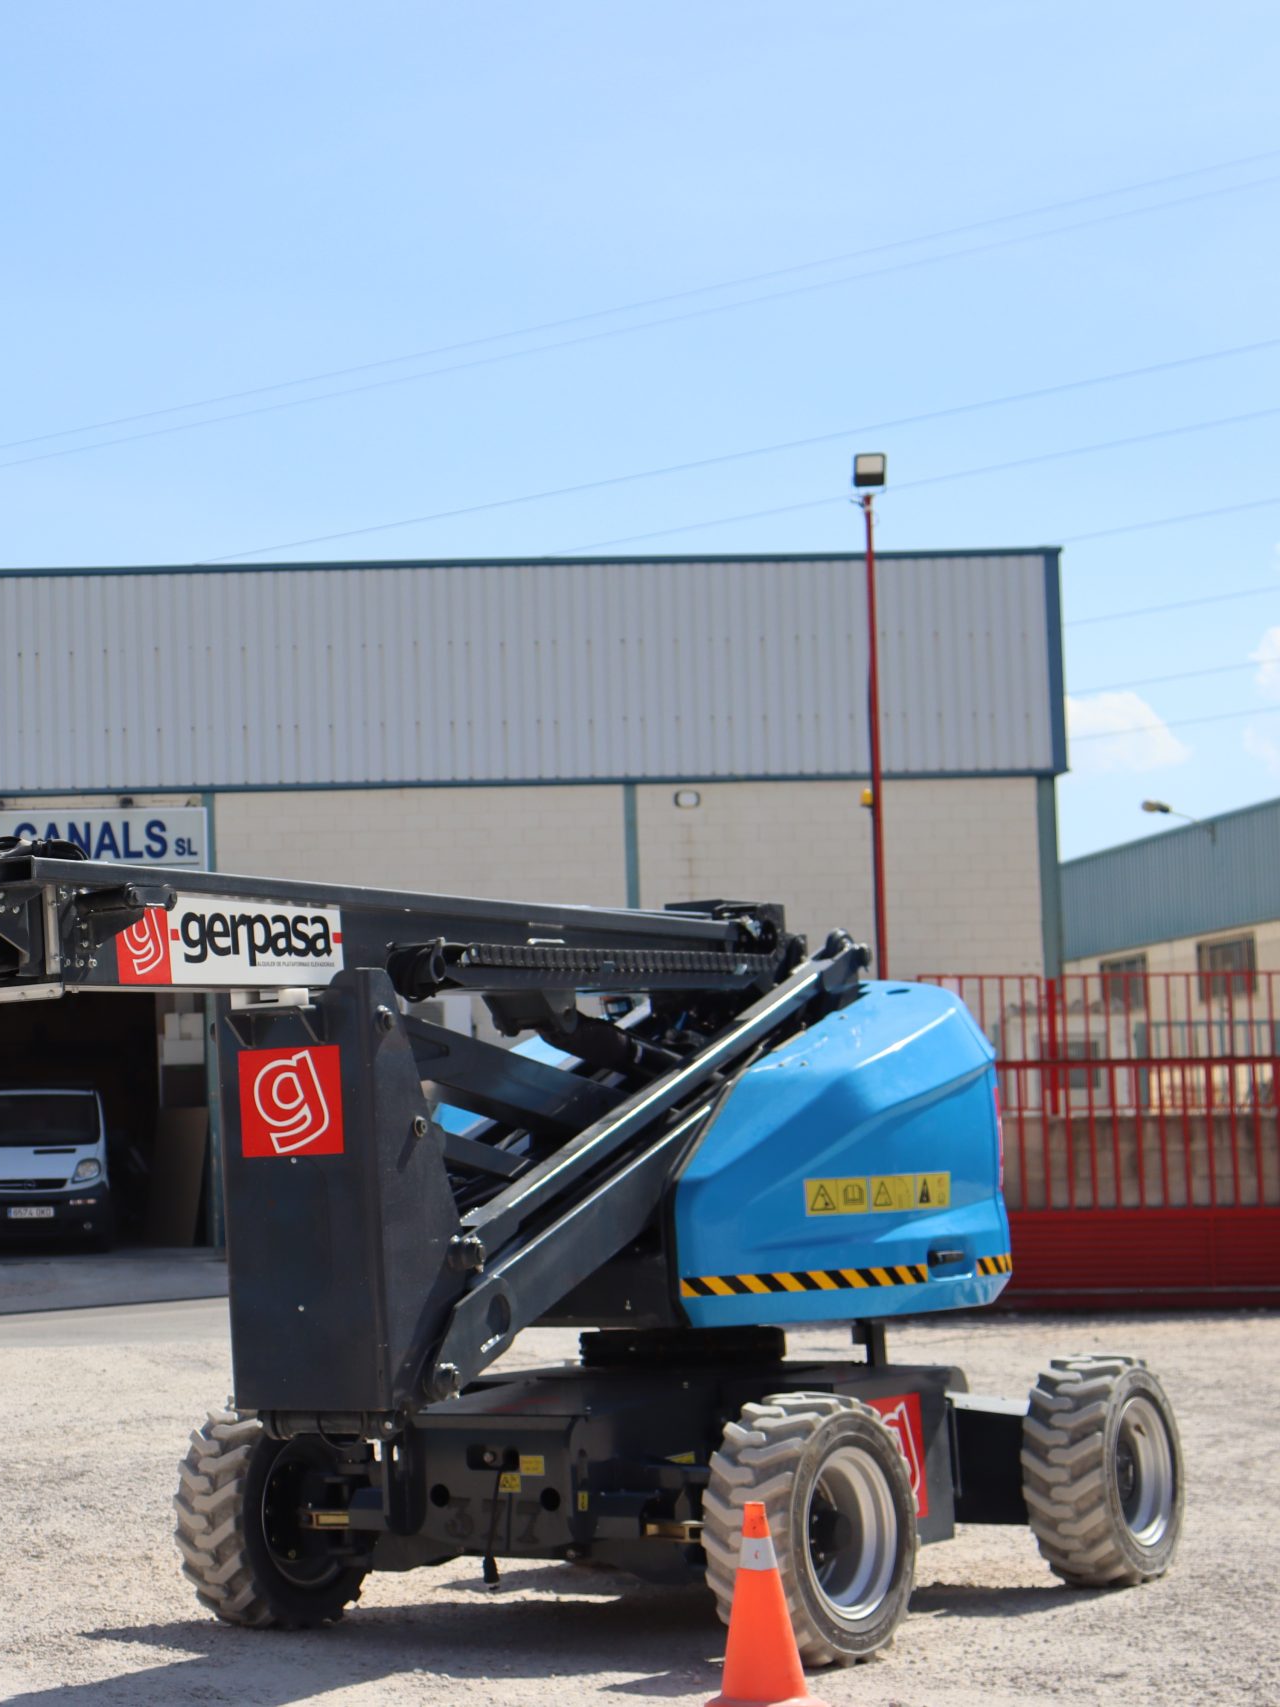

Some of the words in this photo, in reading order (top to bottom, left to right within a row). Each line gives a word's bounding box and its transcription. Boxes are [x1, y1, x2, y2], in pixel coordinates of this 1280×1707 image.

[174, 837, 198, 856] SL
[180, 911, 333, 967] gerpasa
[254, 1049, 330, 1154] g
